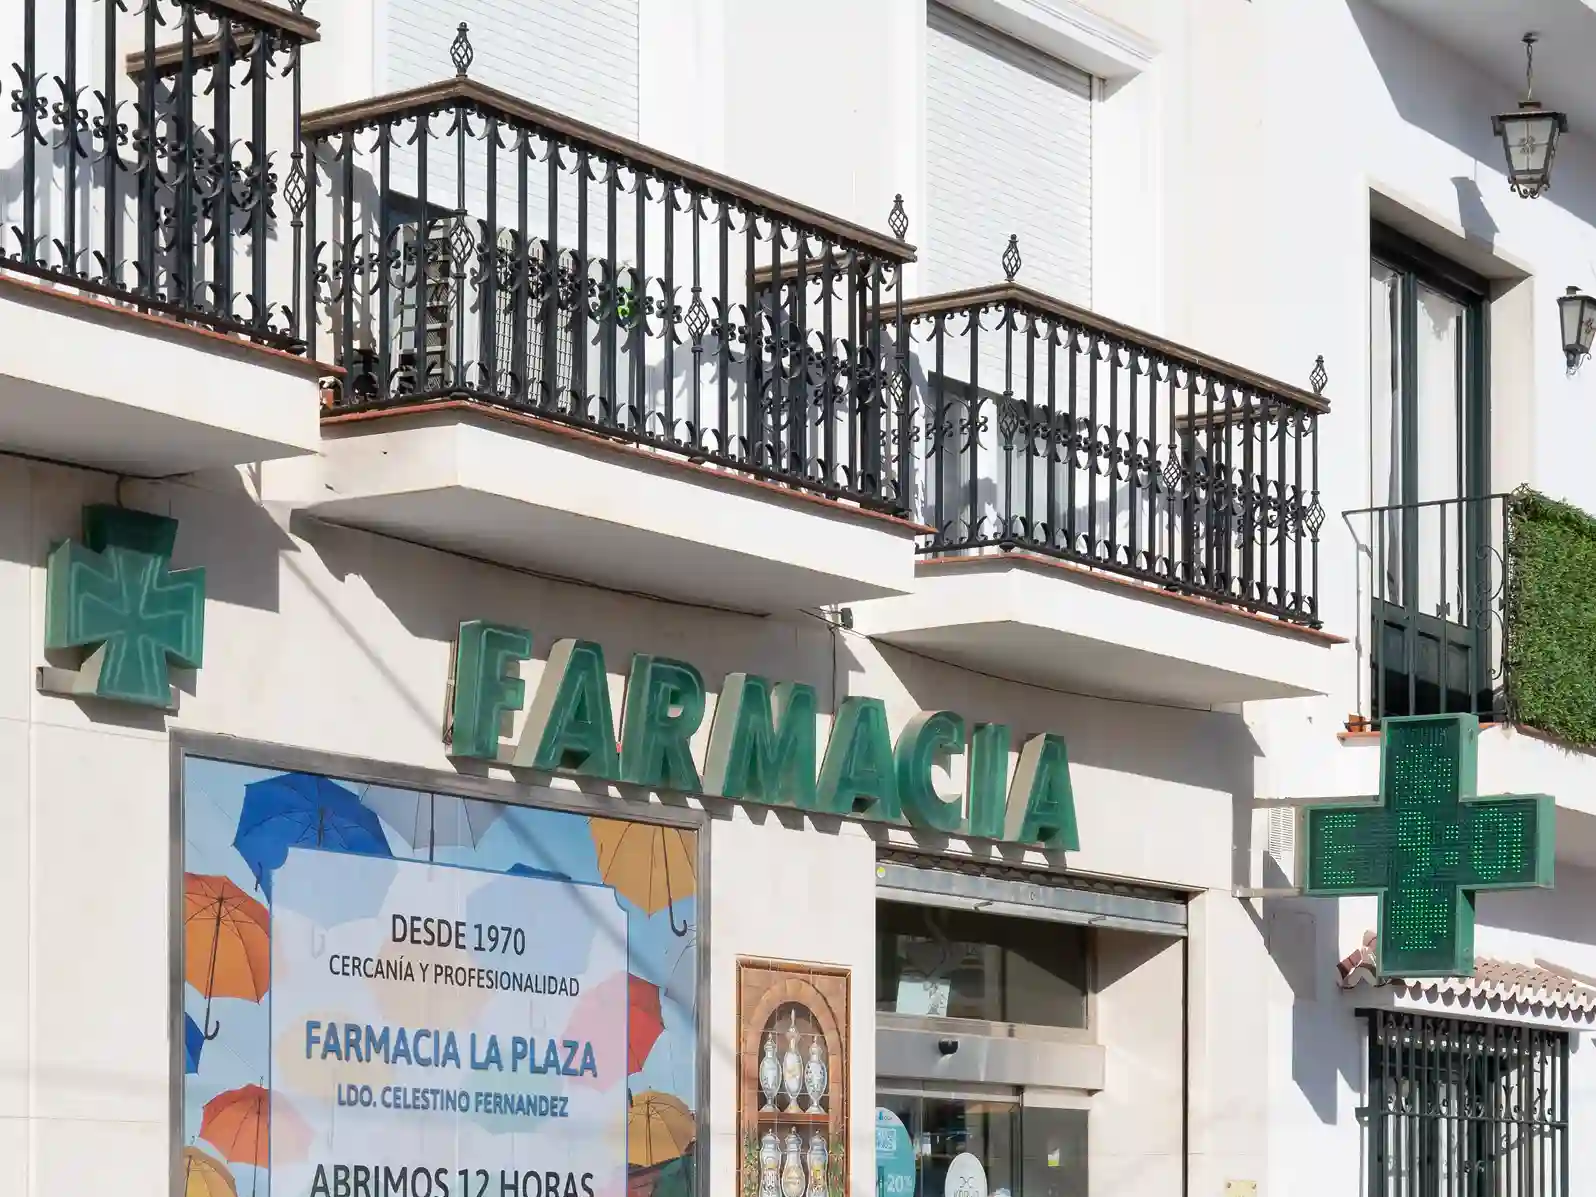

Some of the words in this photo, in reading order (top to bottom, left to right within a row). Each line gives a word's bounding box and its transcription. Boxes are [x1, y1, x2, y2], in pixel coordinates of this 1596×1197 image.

[445, 619, 1081, 852] FARMACIA
[391, 912, 466, 951] DESDE
[473, 922, 526, 956] 1970
[329, 954, 415, 983] CERCANÍA
[419, 964, 431, 983] Y
[434, 964, 580, 997] PROFESIONALIDAD
[305, 1020, 461, 1070] FARMACIA
[470, 1033, 503, 1072] LA
[511, 1036, 598, 1078] PLAZA
[337, 1083, 377, 1108] LDO.
[381, 1085, 469, 1113] CELESTINO
[475, 1091, 569, 1118] FERNANDEZ
